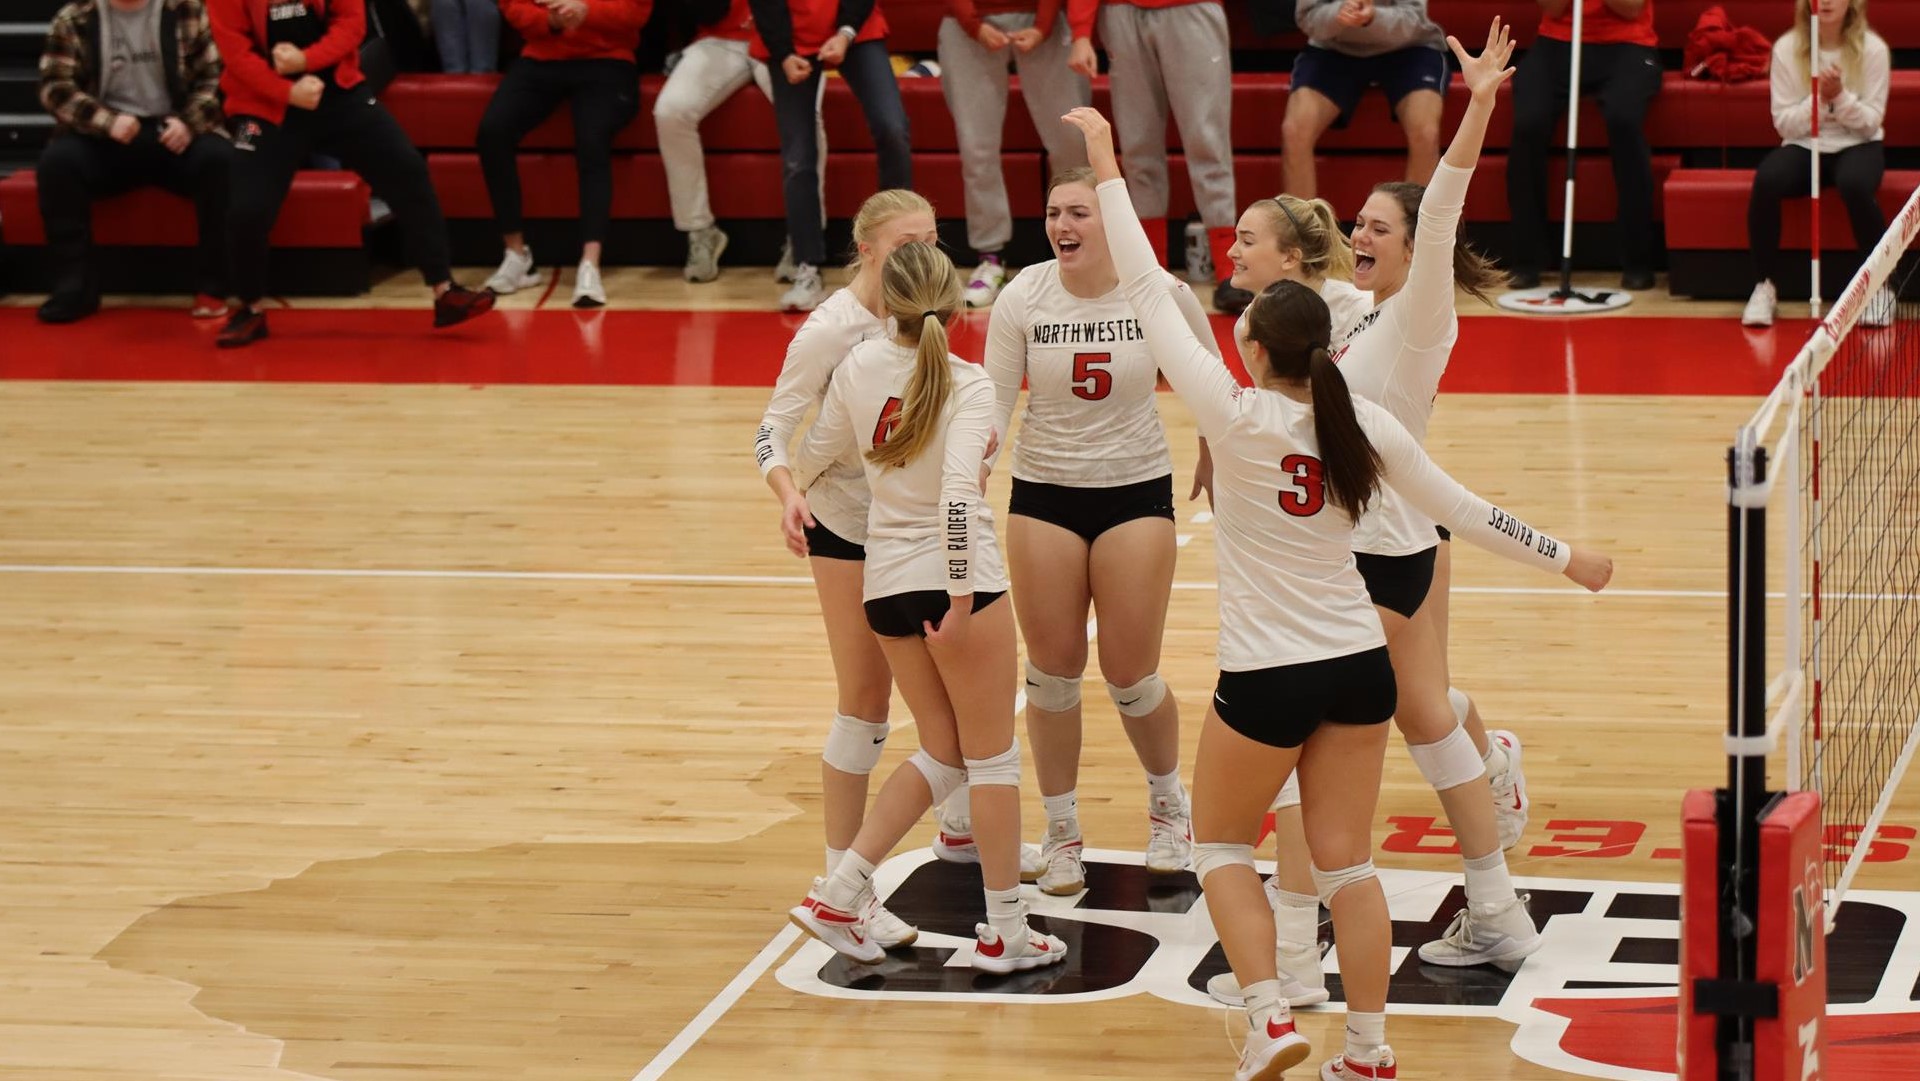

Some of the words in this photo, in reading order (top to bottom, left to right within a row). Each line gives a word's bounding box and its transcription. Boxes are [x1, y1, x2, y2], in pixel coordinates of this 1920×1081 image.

[1033, 318, 1144, 344] NORTHWESTER
[1071, 352, 1113, 401] 5
[1278, 453, 1326, 517] 3
[947, 501, 968, 551] RAIDERS
[1488, 507, 1533, 547] RAIDERS
[1537, 535, 1558, 559] RED
[948, 559, 968, 580] RED
